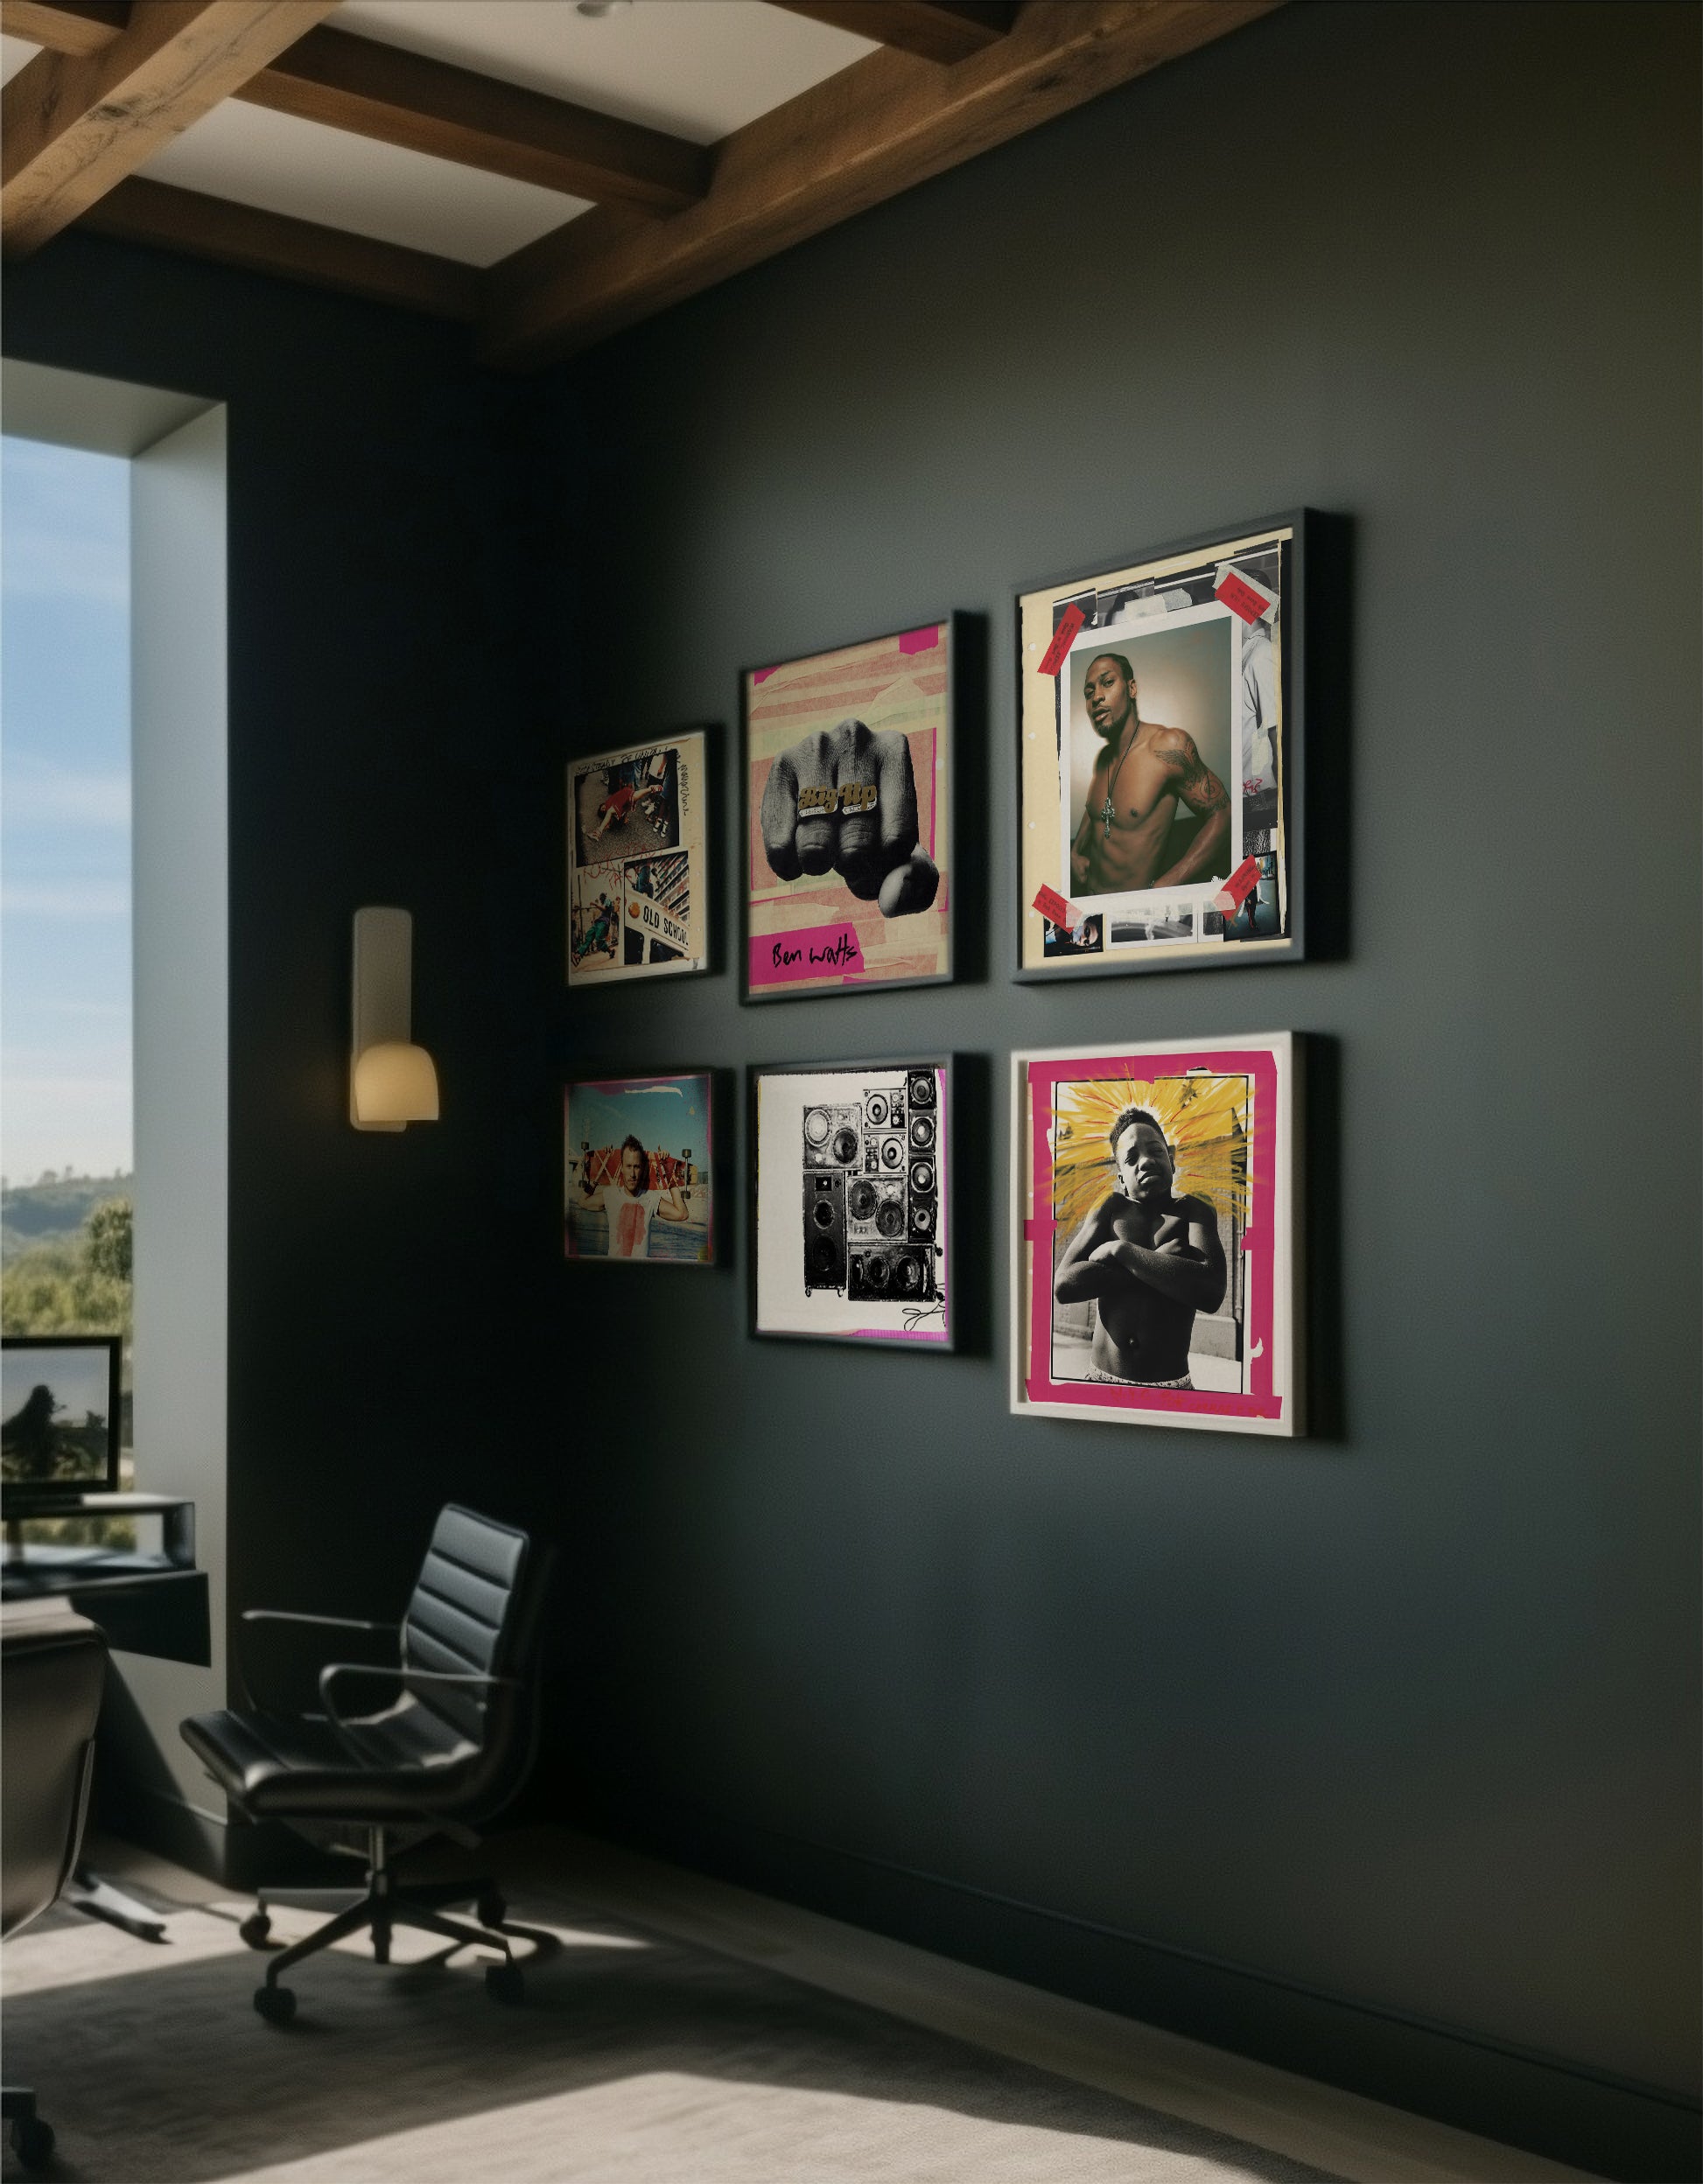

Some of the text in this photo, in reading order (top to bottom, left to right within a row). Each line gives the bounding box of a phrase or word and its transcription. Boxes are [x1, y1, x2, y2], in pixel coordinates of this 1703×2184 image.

[798, 785, 837, 813] Big
[839, 781, 877, 811] Up
[643, 905, 689, 946] OLD SCHOOL
[772, 942, 802, 969] Ben
